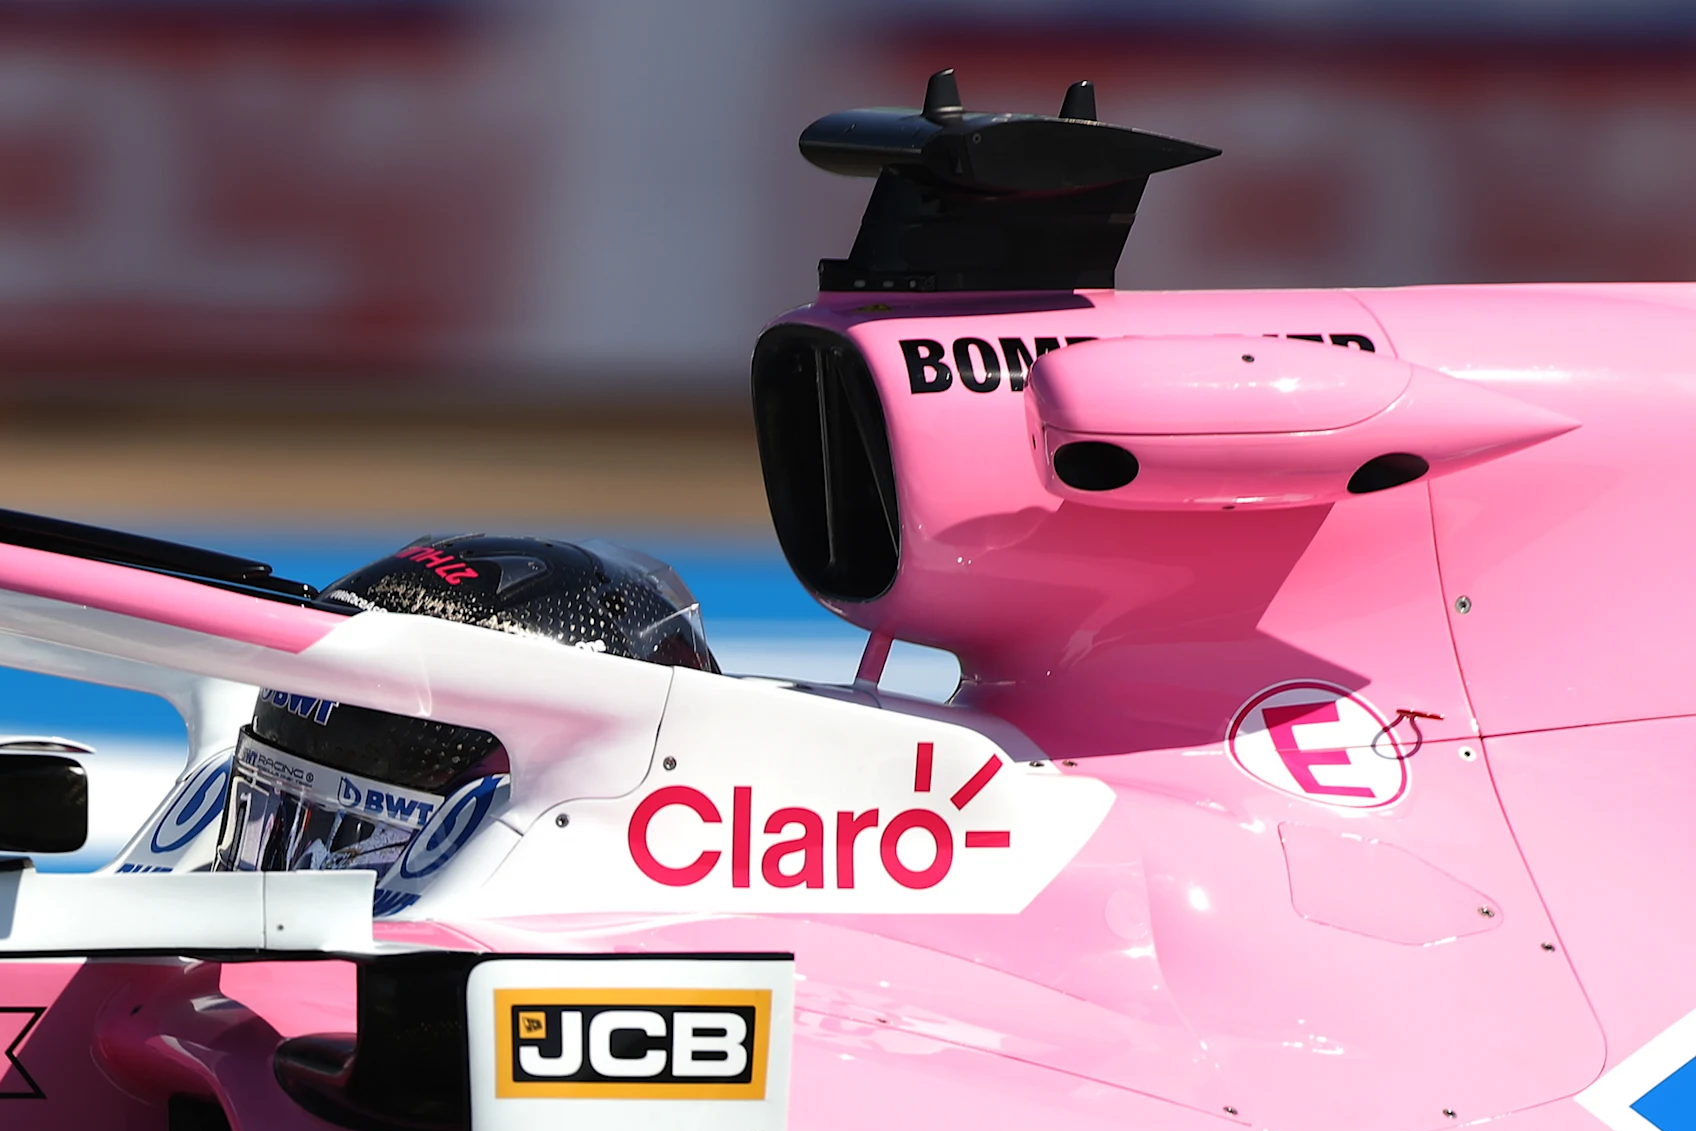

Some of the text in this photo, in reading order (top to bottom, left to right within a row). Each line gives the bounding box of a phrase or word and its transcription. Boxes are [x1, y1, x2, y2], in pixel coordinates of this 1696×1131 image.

[258, 754, 304, 779] RACING
[1261, 701, 1377, 798] E
[363, 789, 434, 826] BWT
[627, 784, 954, 890] Claro
[518, 1010, 749, 1078] JCB
